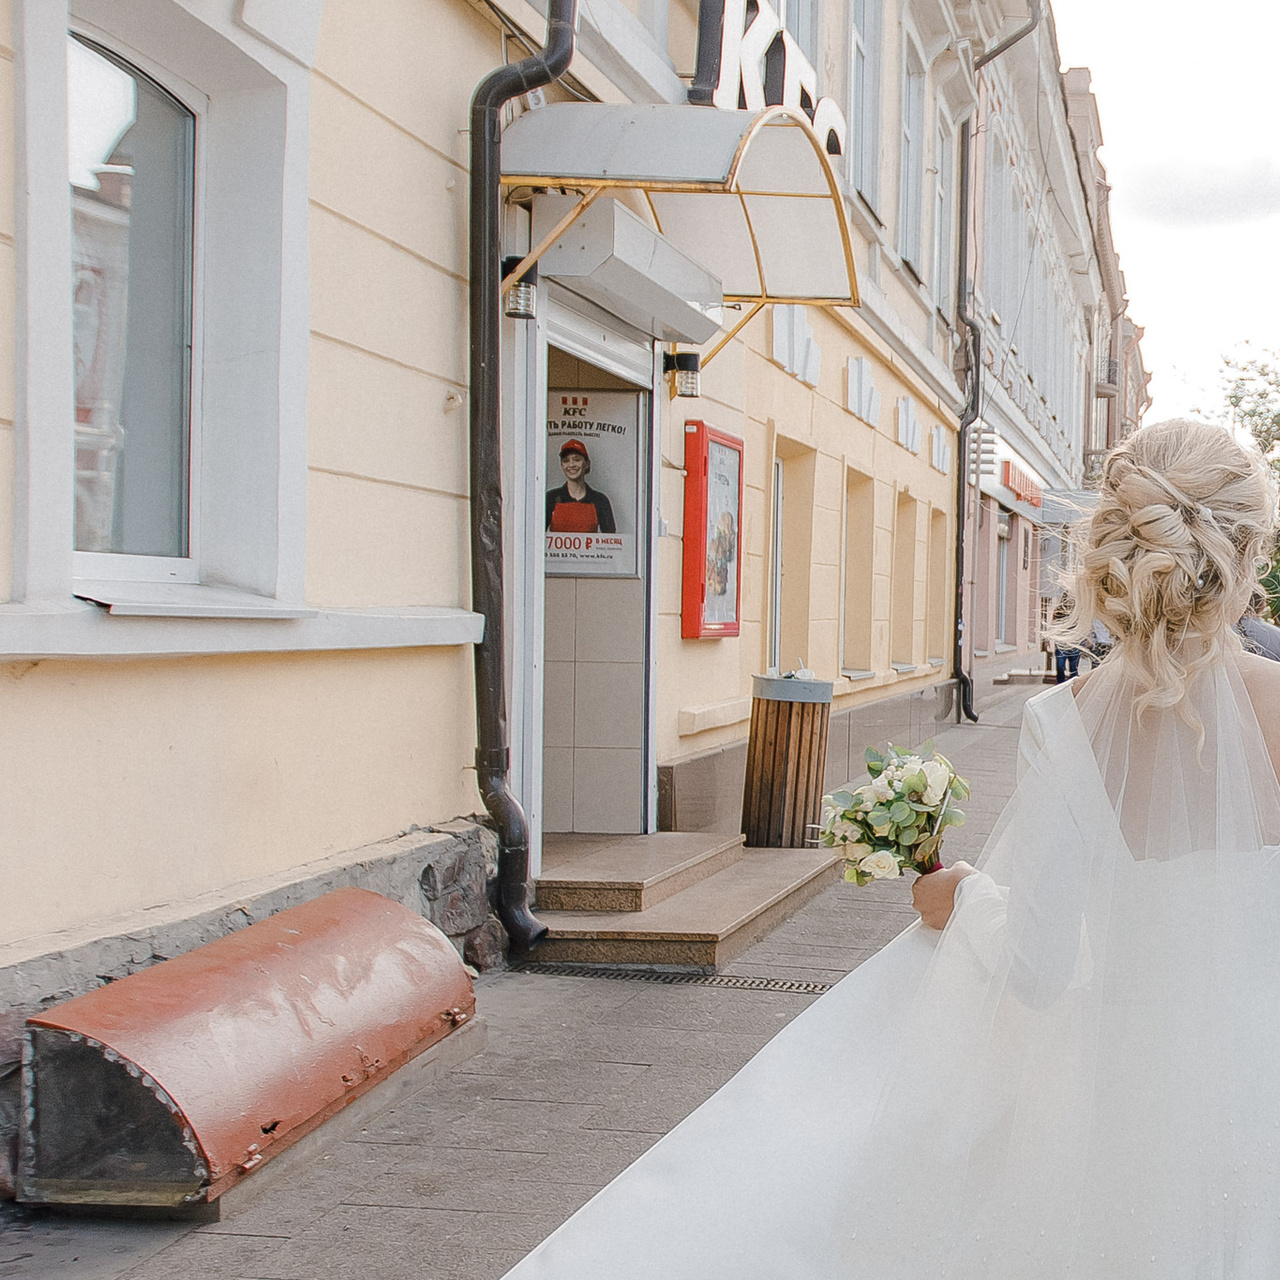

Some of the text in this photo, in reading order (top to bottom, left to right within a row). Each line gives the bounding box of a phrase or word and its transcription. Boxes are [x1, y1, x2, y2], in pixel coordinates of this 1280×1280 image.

[563, 408, 586, 416] KFC
[546, 421, 626, 435] ТЬ РАБОТУ ЛЕГКО!
[601, 538, 622, 546] МЕСЯЦ
